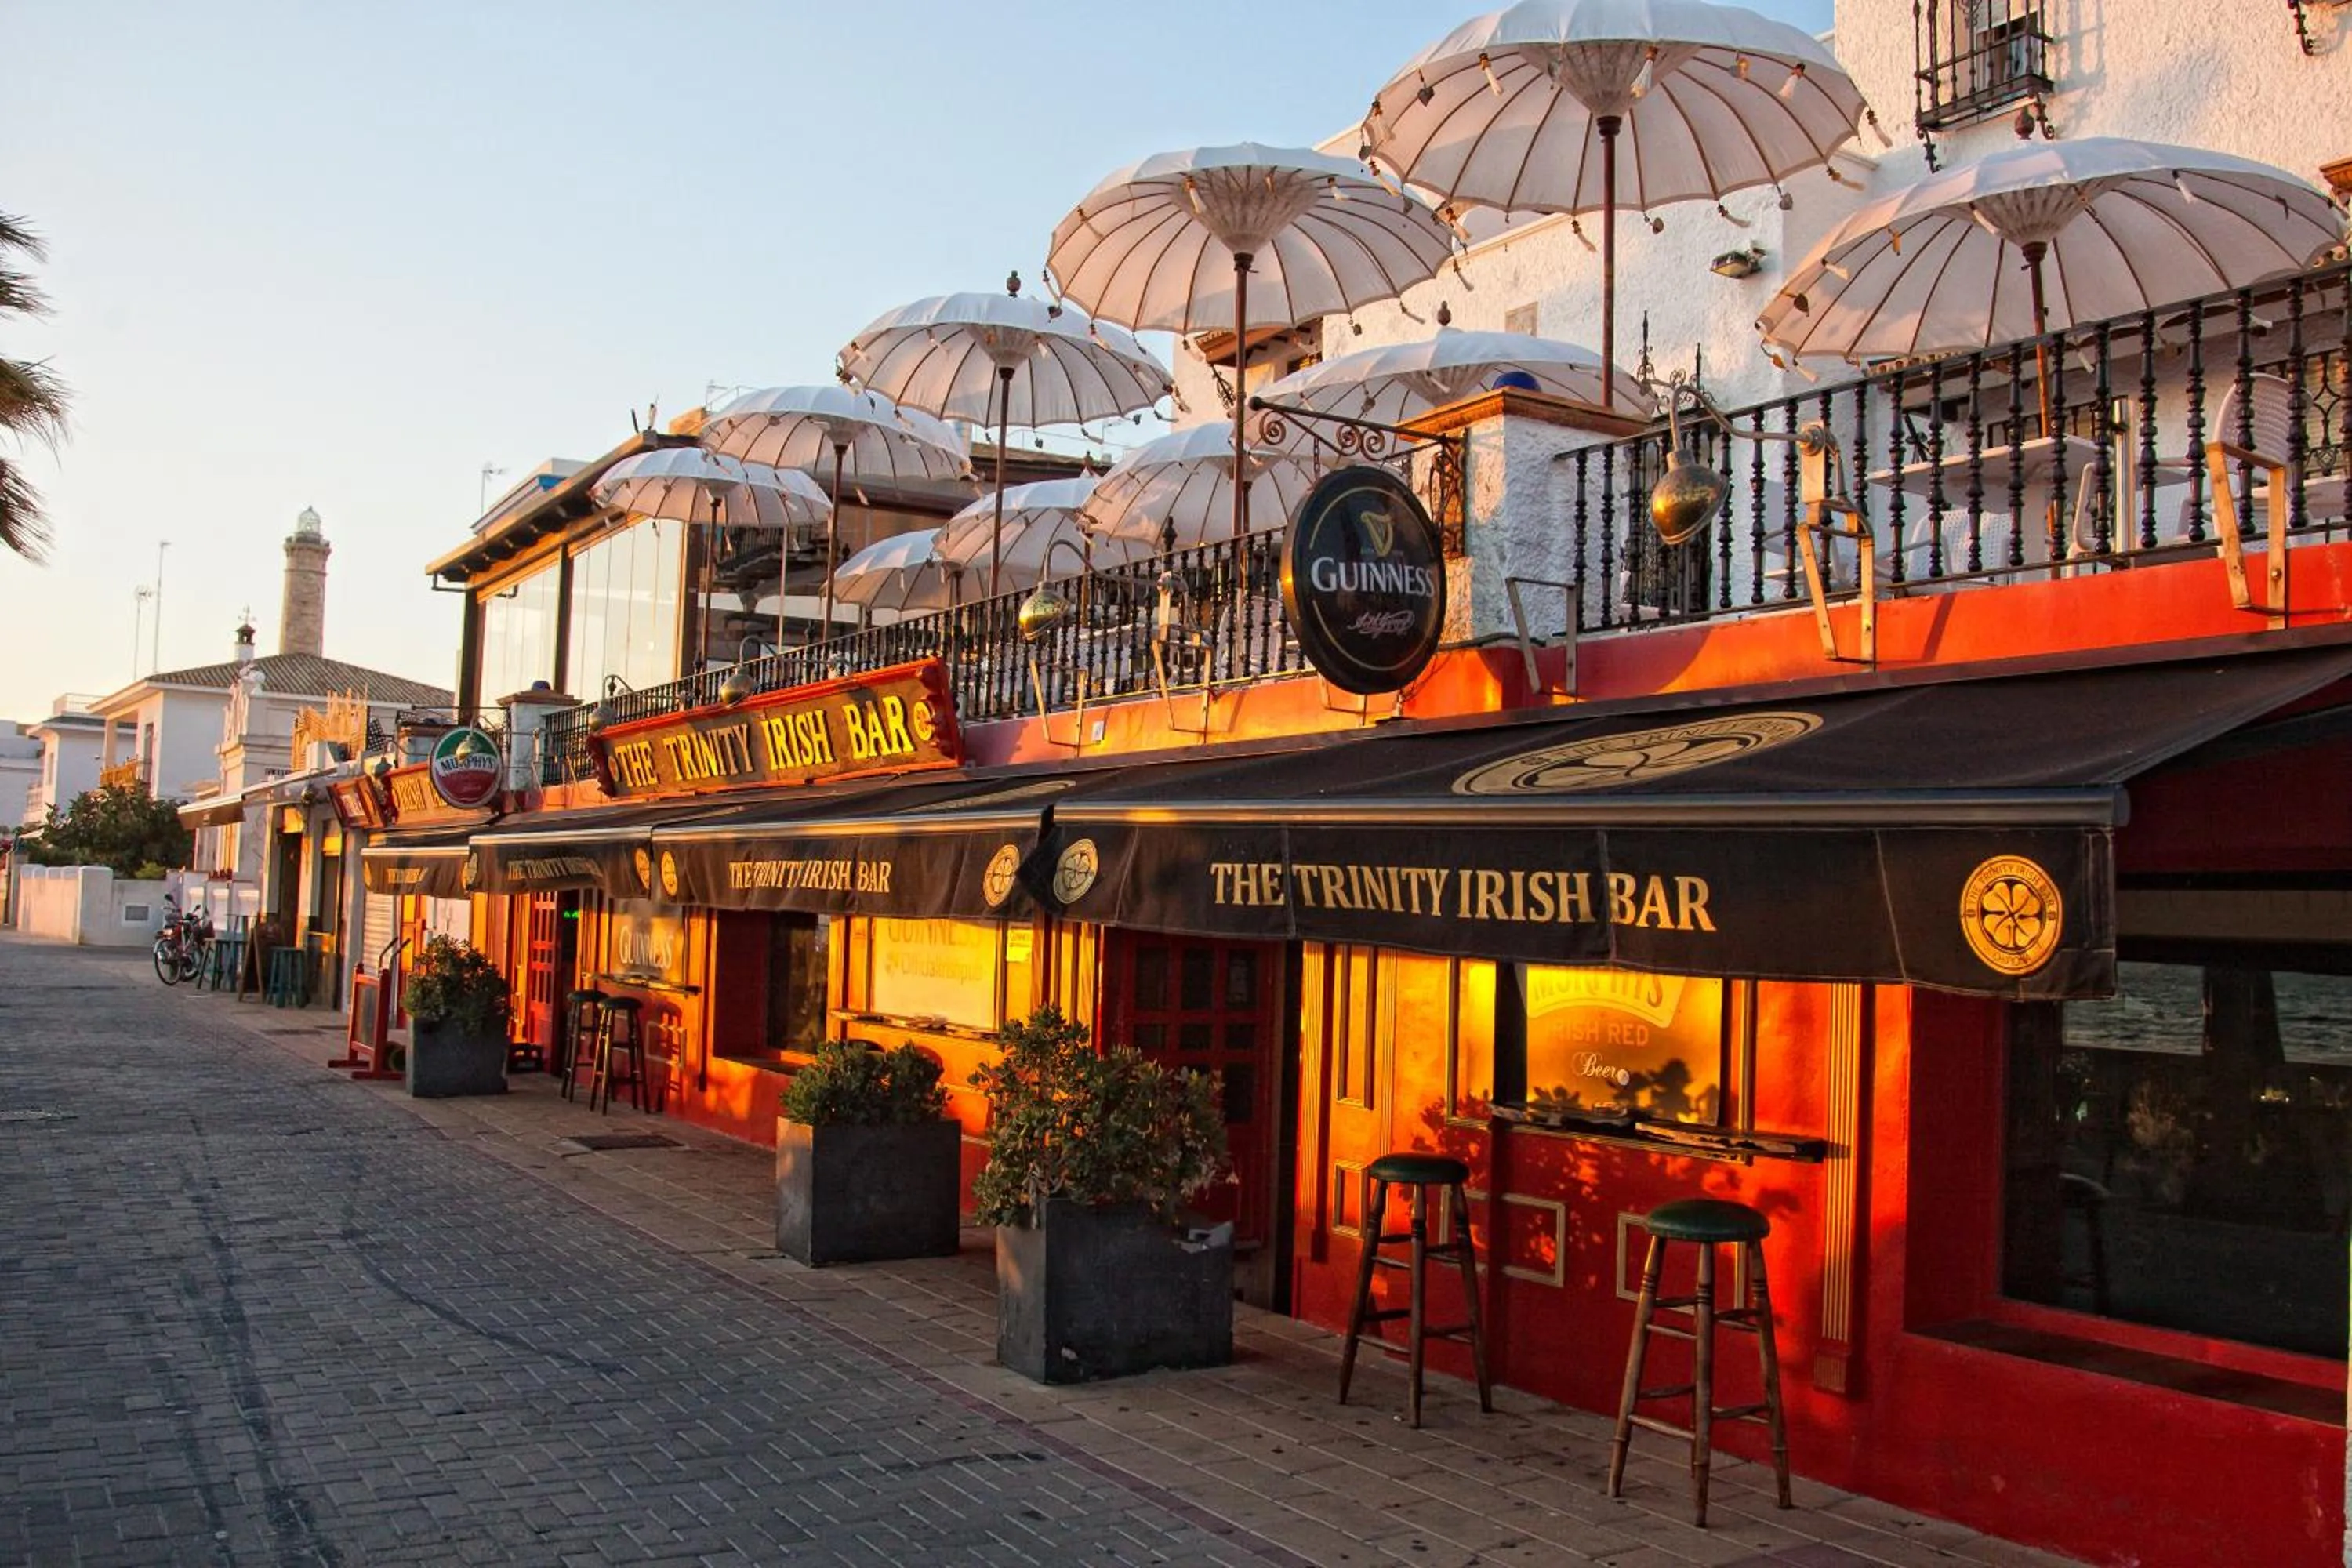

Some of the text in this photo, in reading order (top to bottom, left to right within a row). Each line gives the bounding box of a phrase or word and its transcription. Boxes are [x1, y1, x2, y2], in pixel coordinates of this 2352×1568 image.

[1311, 556, 1435, 597] GUINNESS
[614, 695, 915, 787] THE TRINITY IRISH BAR
[728, 860, 891, 893] THE TRINITY IRISH BAR
[1979, 864, 2013, 883] TRINITY
[2016, 865, 2040, 885] IRISH
[1210, 862, 1717, 932] THE TRINITY IRISH BAR
[1550, 1018, 1649, 1047] RISH RED
